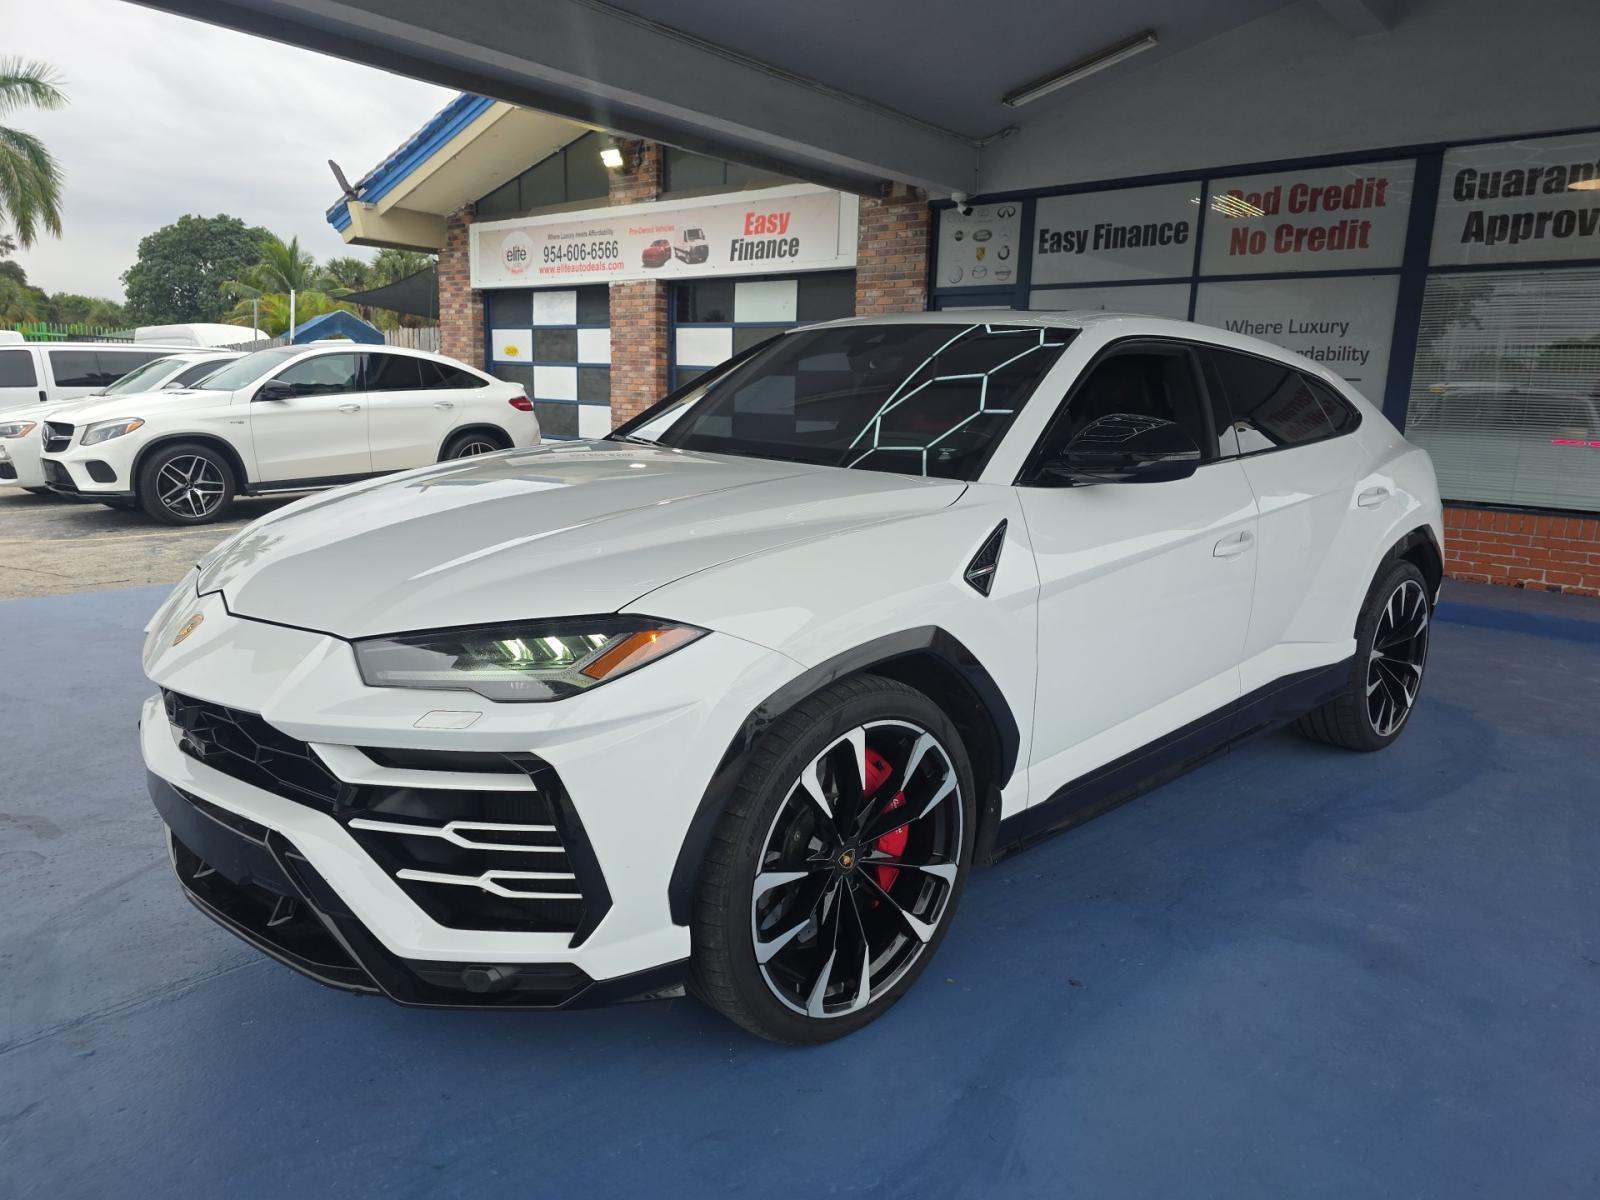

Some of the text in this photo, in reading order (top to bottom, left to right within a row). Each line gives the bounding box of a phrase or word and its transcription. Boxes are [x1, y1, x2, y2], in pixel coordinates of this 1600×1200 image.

[1453, 159, 1600, 201] Guaran
[1288, 178, 1389, 214] Credit
[743, 212, 791, 236] Easy
[1461, 208, 1600, 246] Approv
[729, 237, 800, 262] Finance
[1039, 221, 1190, 254] Easy Finance
[1229, 220, 1372, 256] No Credit
[506, 246, 527, 262] elite
[543, 240, 619, 263] 954-606-6566
[539, 261, 624, 275] www.eliteautodeals.com
[1225, 319, 1350, 338] Where Luxury
[1296, 345, 1370, 366] dability
